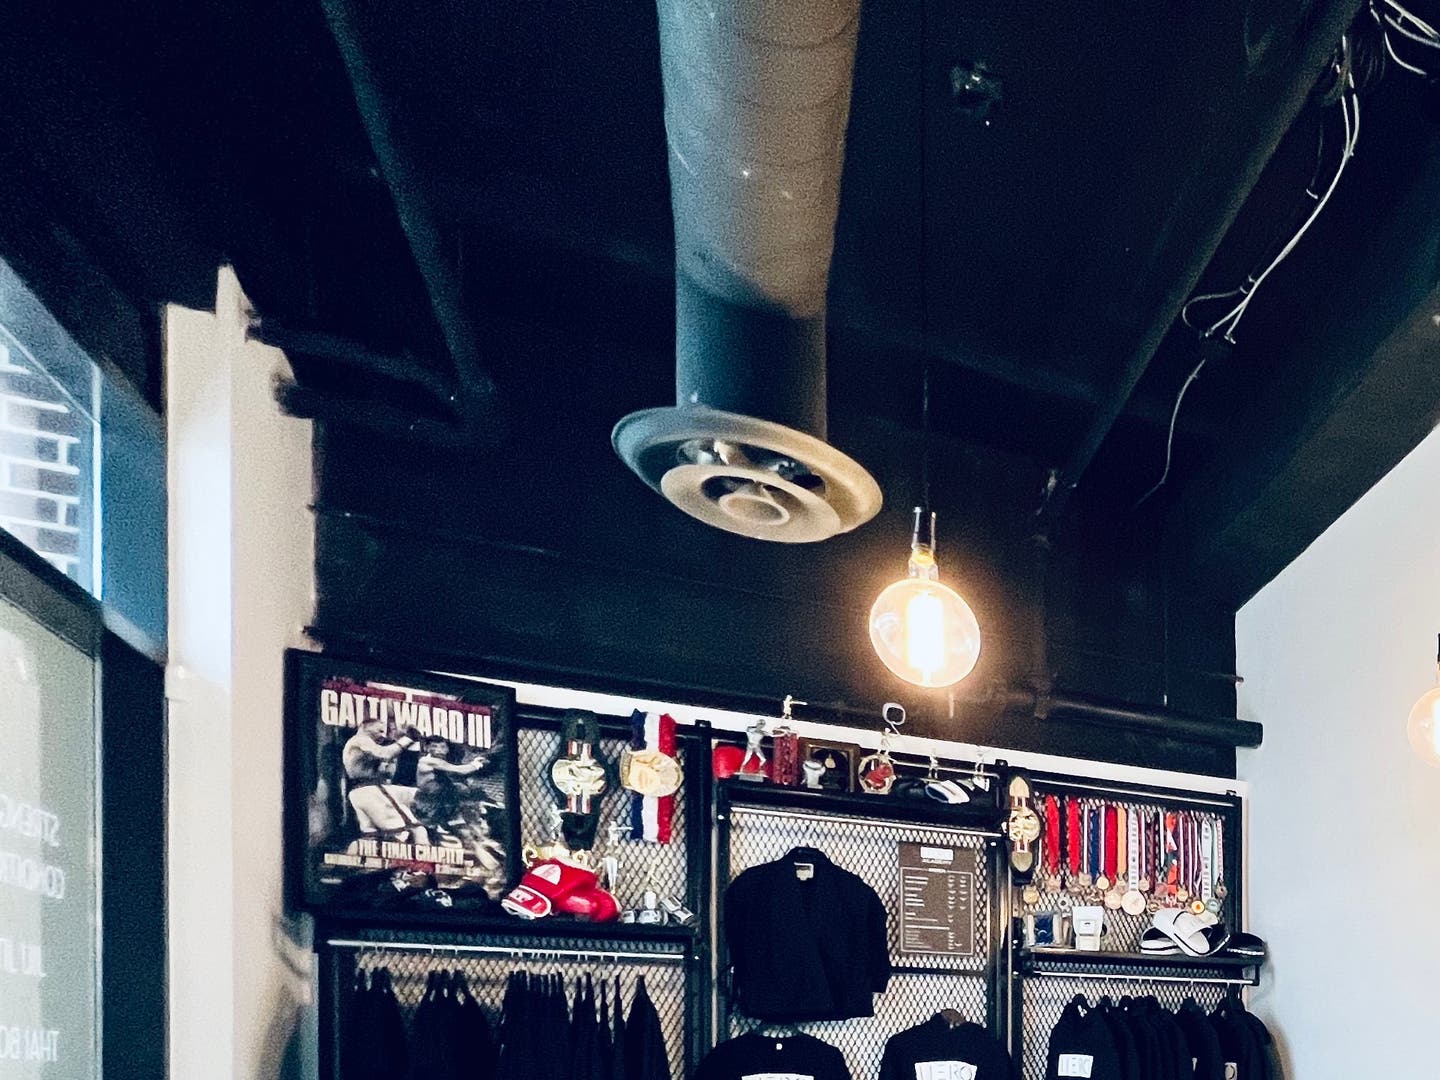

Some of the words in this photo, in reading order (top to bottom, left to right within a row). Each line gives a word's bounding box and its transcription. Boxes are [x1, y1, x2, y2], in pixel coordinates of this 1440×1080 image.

[321, 689, 388, 738] GATTI
[393, 701, 464, 744] WARD
[467, 713, 492, 749] III
